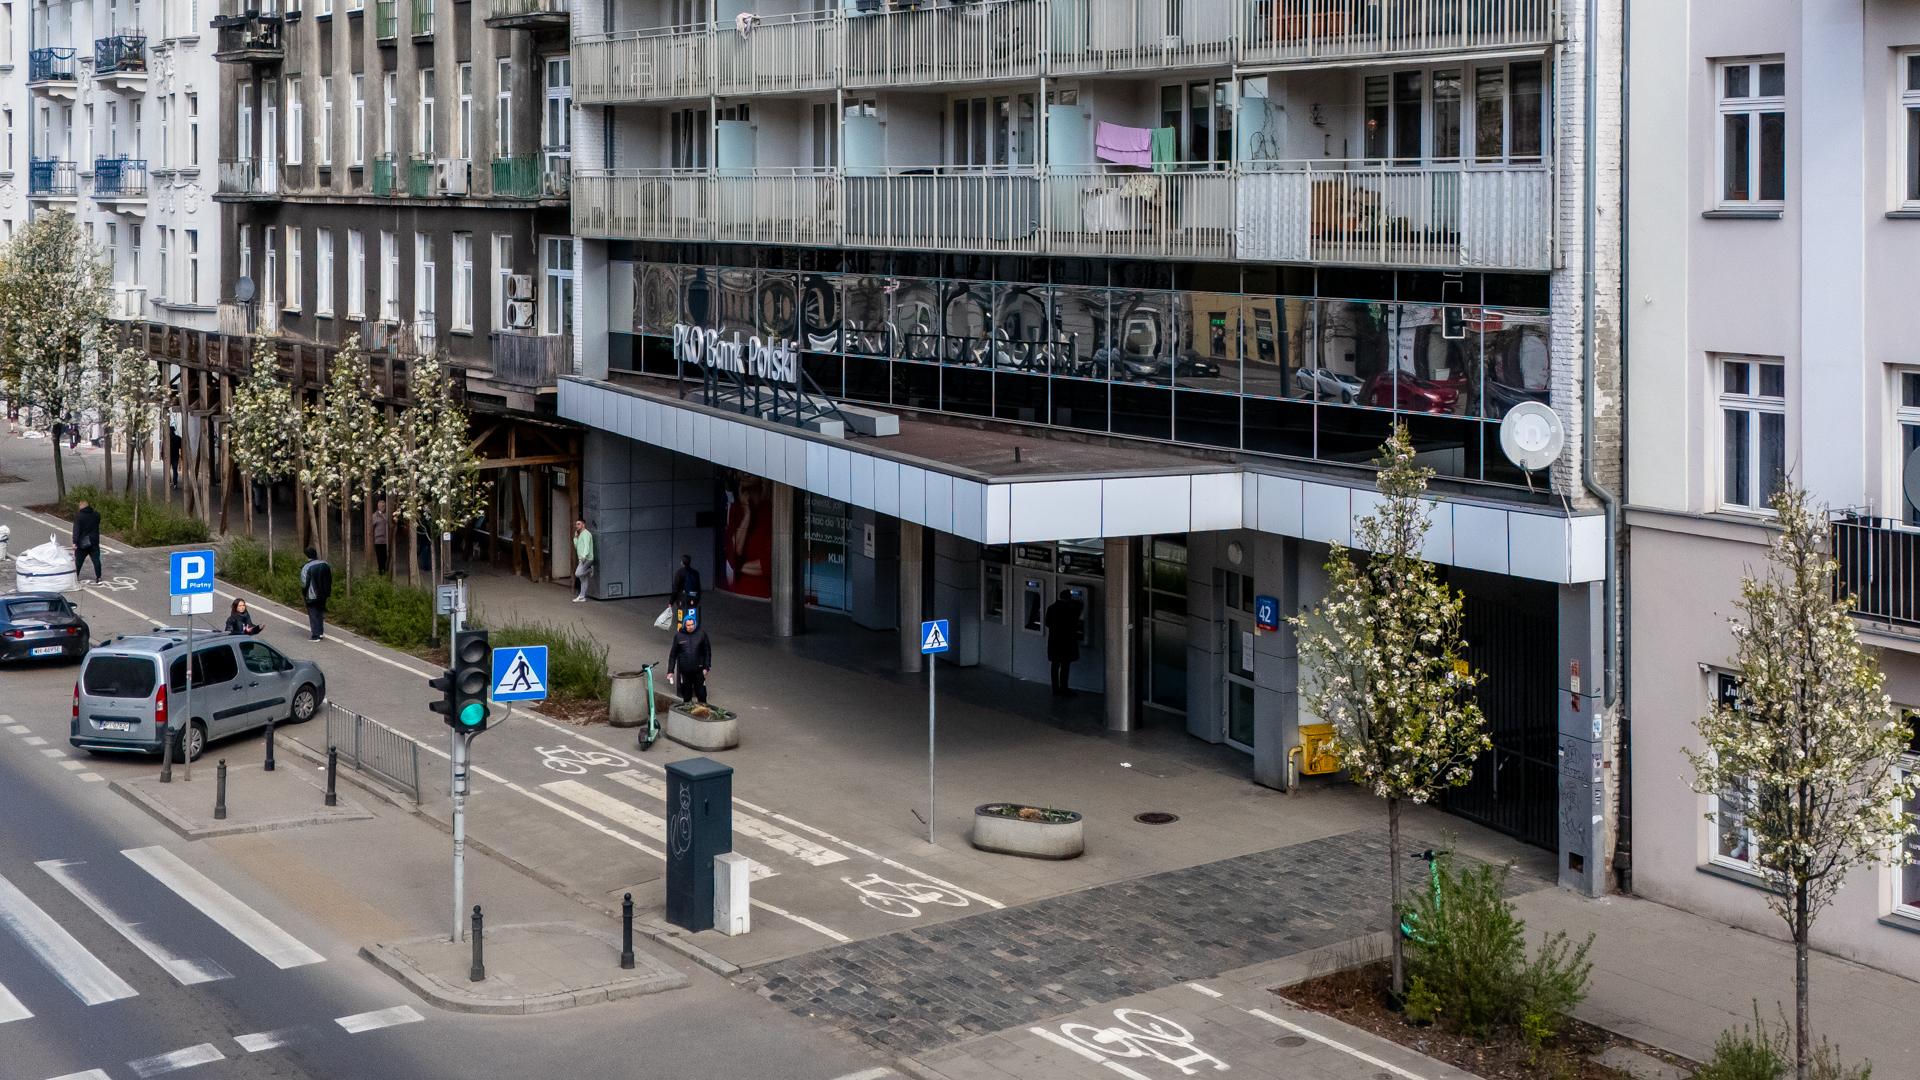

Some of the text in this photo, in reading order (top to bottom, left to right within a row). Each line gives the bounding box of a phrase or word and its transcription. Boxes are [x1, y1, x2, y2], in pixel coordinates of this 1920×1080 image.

[674, 323, 798, 383] PKO Bank Polski
[181, 556, 206, 590] P
[1259, 605, 1272, 623] 42
